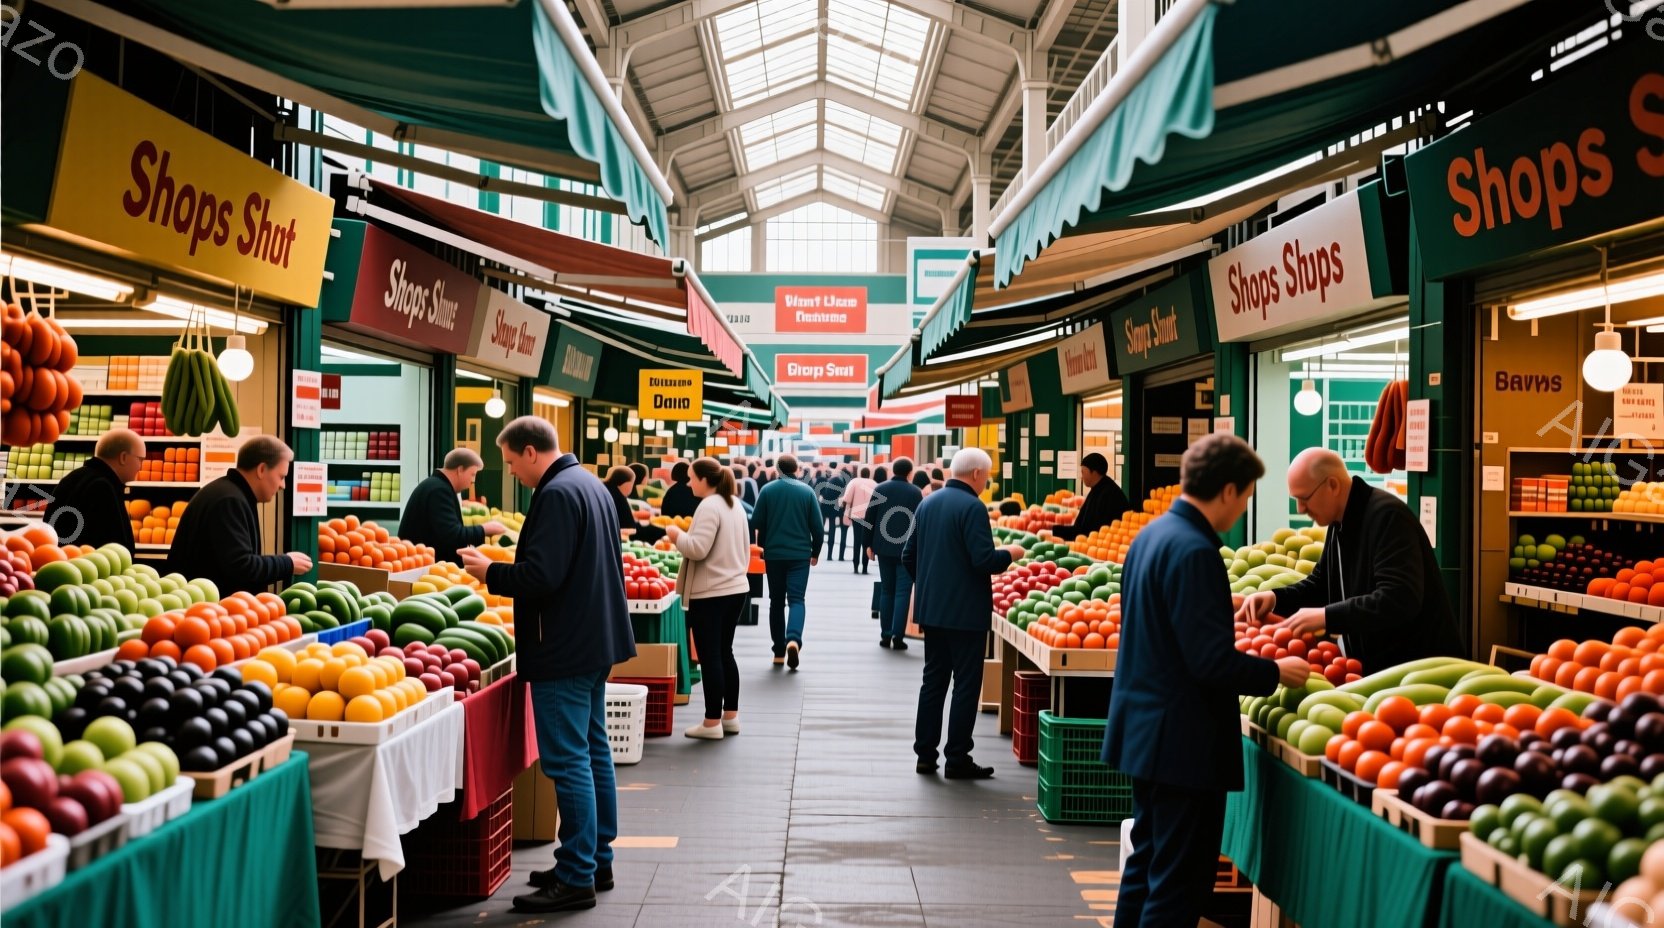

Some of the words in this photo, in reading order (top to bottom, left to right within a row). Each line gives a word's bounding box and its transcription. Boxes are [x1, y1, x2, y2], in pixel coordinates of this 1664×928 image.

[122, 140, 233, 256] Shops
[1447, 127, 1613, 237] Shops
[384, 259, 430, 329] Shops
[1228, 261, 1280, 321] Shops
